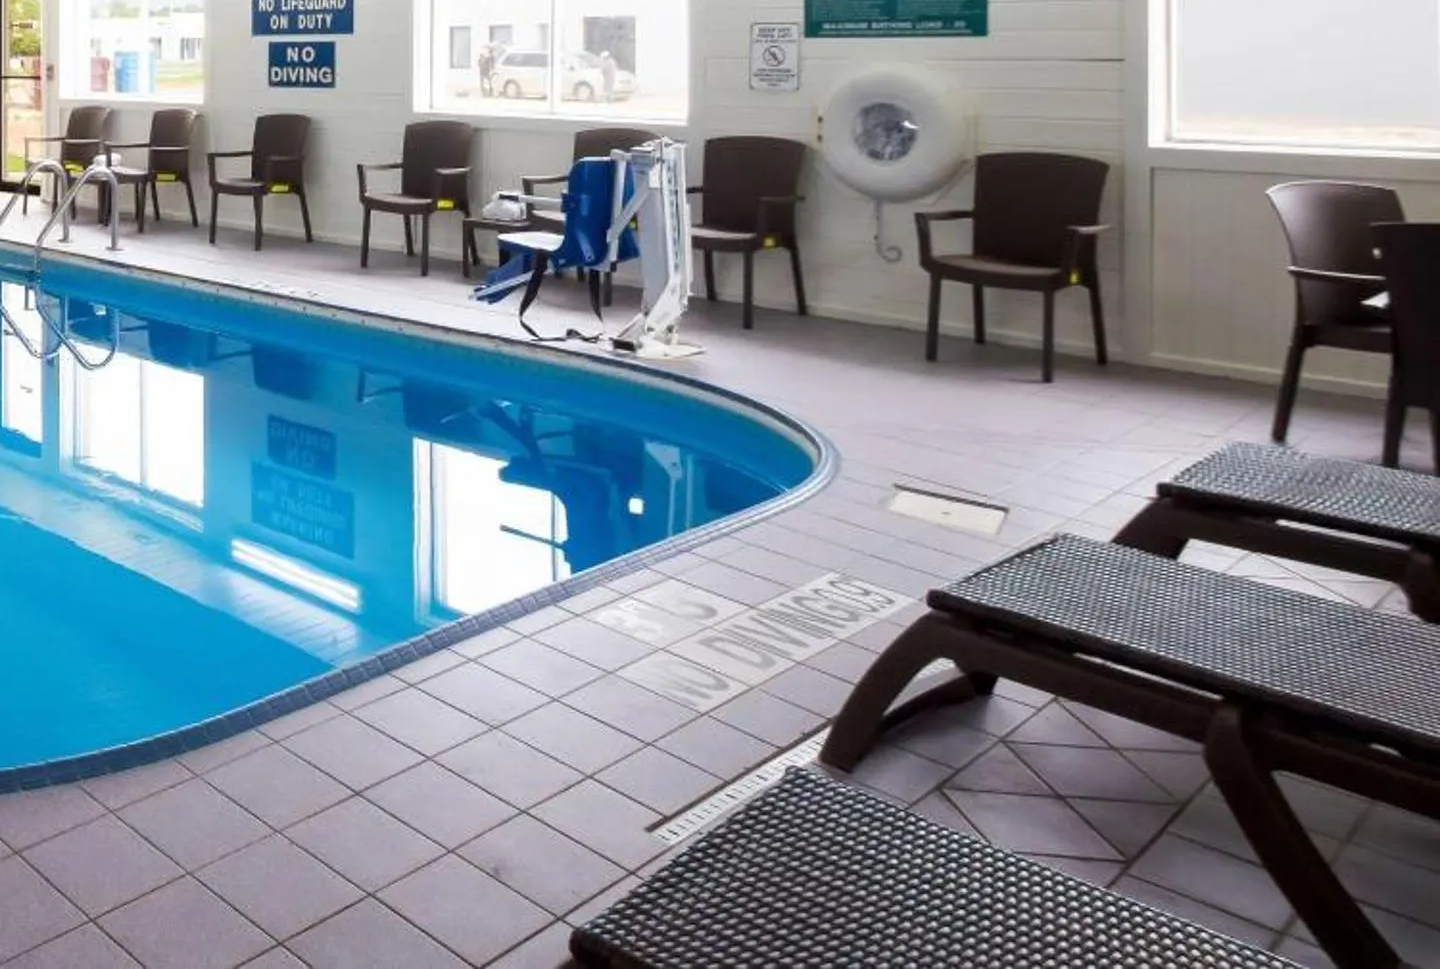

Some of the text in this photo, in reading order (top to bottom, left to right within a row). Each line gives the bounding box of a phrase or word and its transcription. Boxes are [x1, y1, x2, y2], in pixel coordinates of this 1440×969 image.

[270, 14, 333, 29] ON DUTY
[286, 47, 315, 62] NO
[271, 66, 333, 83] DIVING
[695, 595, 862, 670] DIVING
